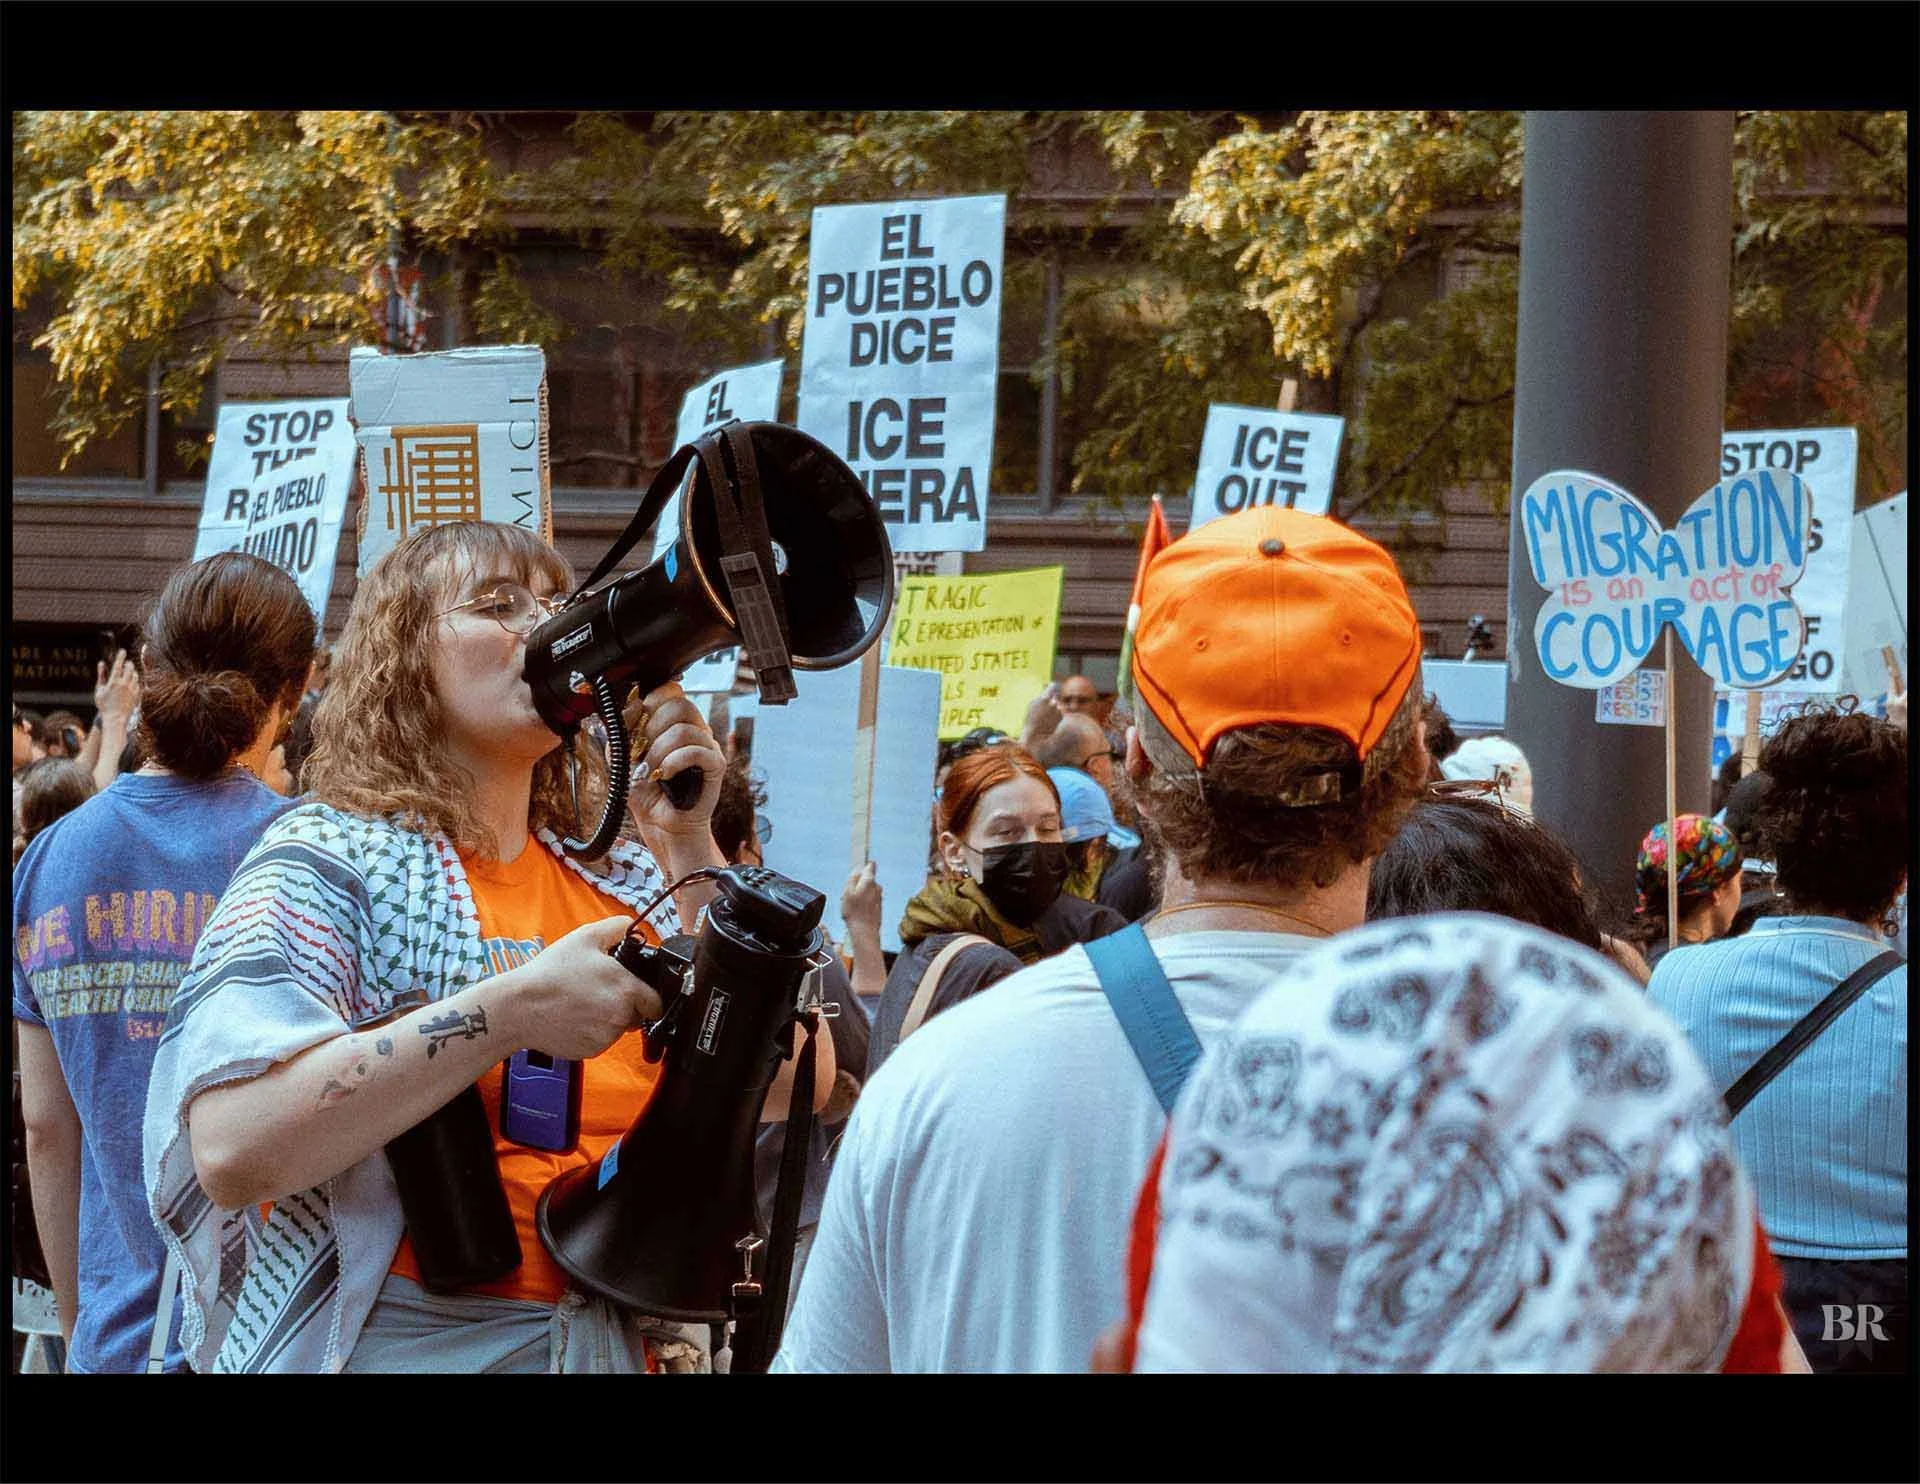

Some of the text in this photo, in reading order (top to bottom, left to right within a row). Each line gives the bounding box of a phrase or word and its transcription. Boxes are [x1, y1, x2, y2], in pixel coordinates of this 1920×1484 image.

[880, 214, 934, 261] EL
[815, 259, 993, 317] PUEBLO
[850, 316, 956, 367] DICE
[704, 381, 733, 427] EL
[243, 409, 334, 447] STOP
[847, 397, 946, 462] ICE
[1230, 424, 1310, 475] ICE
[252, 447, 316, 482] TH
[1721, 440, 1821, 477] STOP
[271, 473, 326, 517] PUEBLO
[860, 466, 980, 523] ERA
[1215, 474, 1306, 515] OUT
[1526, 471, 1803, 583] MIGRATION
[1607, 577, 1643, 600] an
[1689, 565, 1744, 602] act
[1752, 563, 1784, 598] of
[970, 651, 1030, 672] STATES
[1541, 598, 1797, 683] COURAGE
